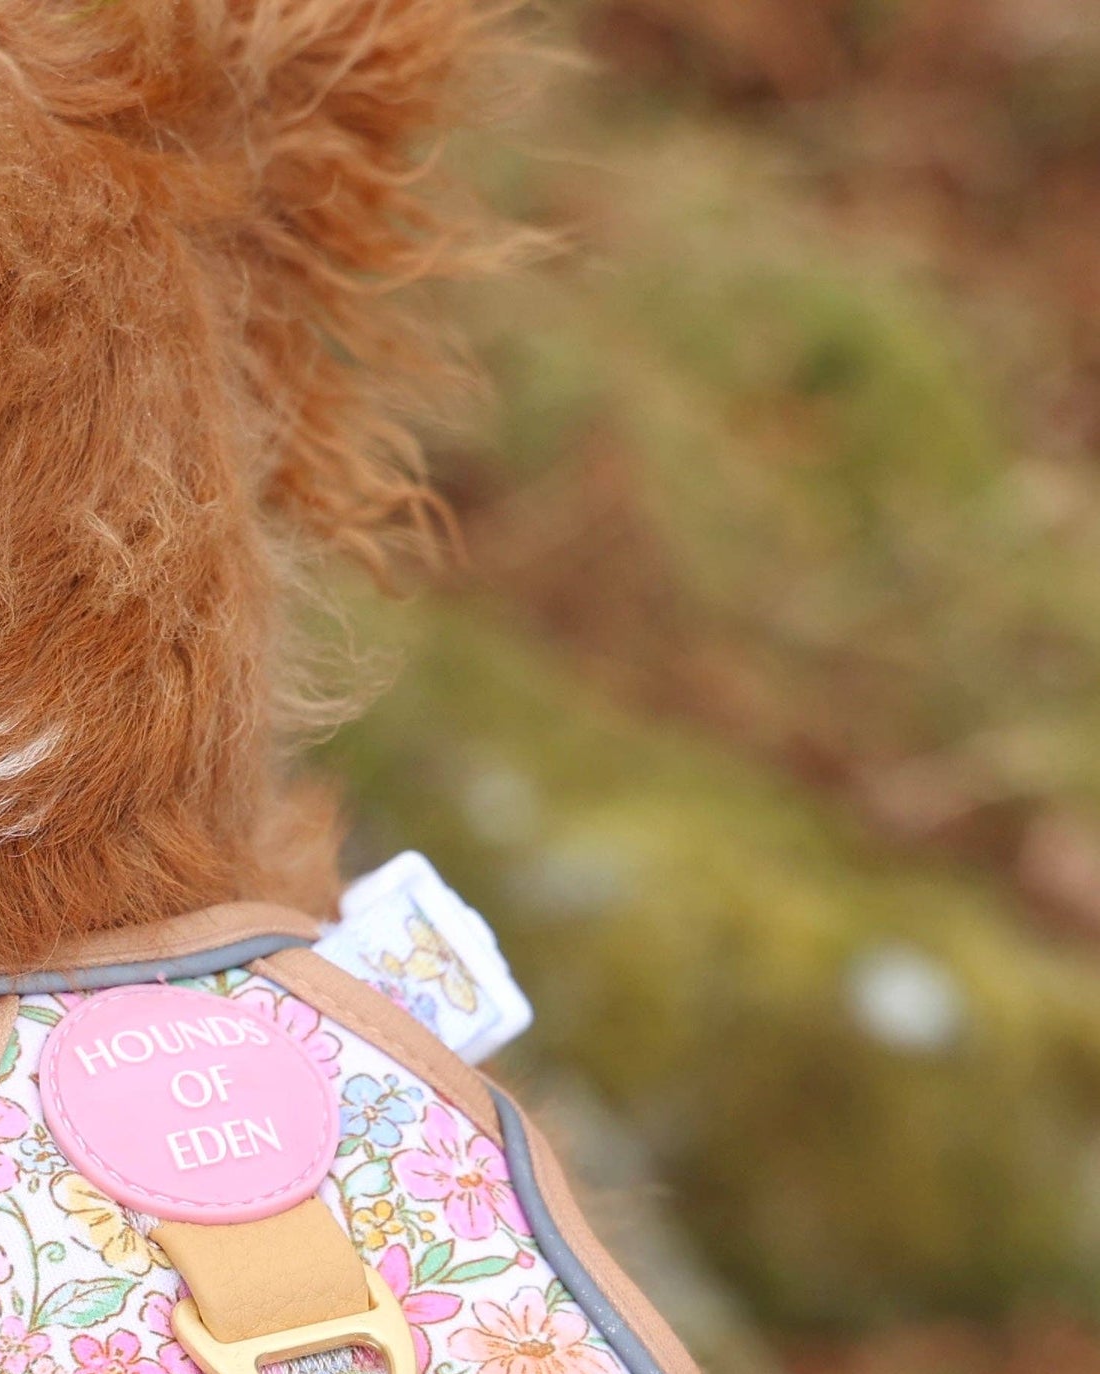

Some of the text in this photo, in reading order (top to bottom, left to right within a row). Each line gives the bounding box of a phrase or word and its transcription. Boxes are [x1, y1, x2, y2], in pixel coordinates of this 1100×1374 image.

[74, 1016, 270, 1075] HOUNDS
[170, 1064, 233, 1108] OF
[166, 1117, 282, 1170] EDEN
